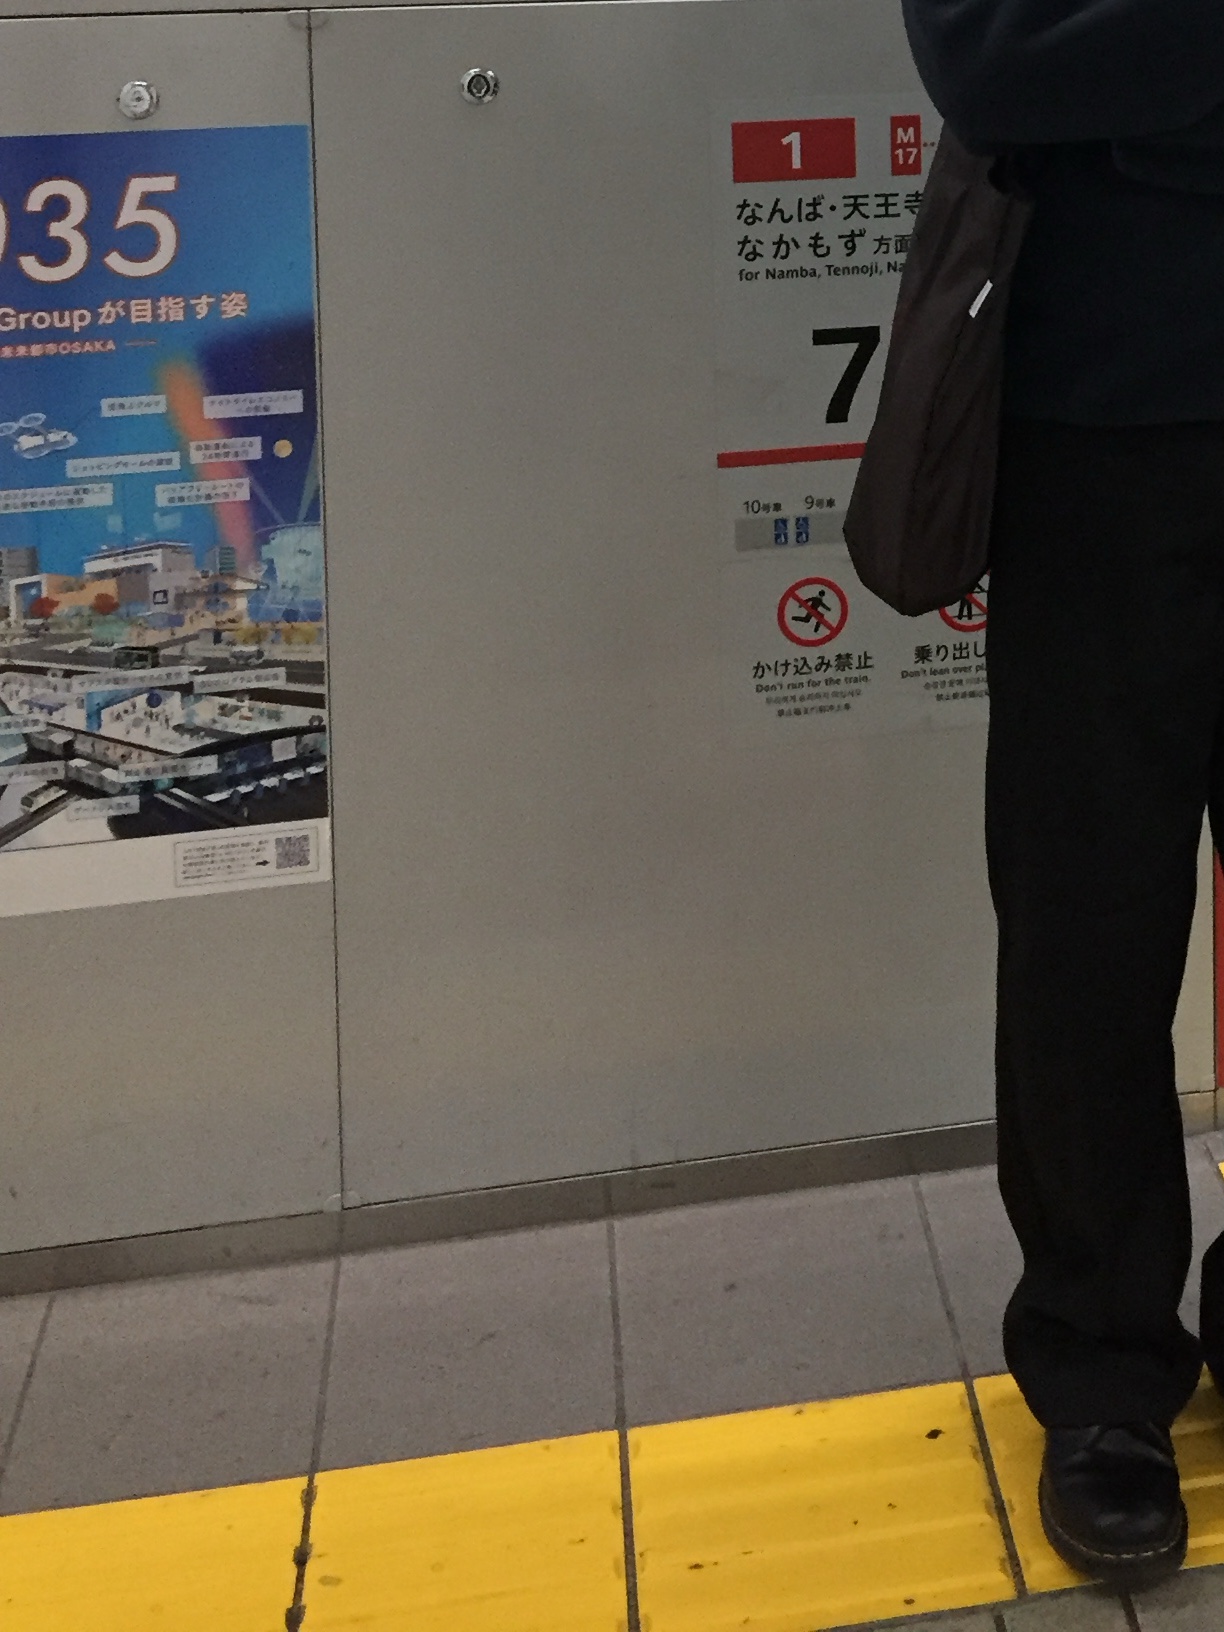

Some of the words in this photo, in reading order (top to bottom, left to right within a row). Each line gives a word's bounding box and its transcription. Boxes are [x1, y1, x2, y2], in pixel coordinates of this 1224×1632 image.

[781, 131, 801, 169] 1
[896, 128, 915, 143] M
[894, 147, 919, 165] 17
[736, 190, 924, 226] なんば・天王寺
[739, 269, 760, 282] for
[765, 264, 821, 280] Namba,
[825, 262, 883, 278] Tennoji,
[0, 307, 91, 333] Group
[98, 292, 249, 325] が目指す姿
[812, 325, 880, 424] 7
[752, 651, 874, 680] かけ込み禁止
[755, 680, 783, 694] Don't
[786, 681, 804, 690] run
[807, 677, 822, 688] for
[824, 676, 842, 687] the
